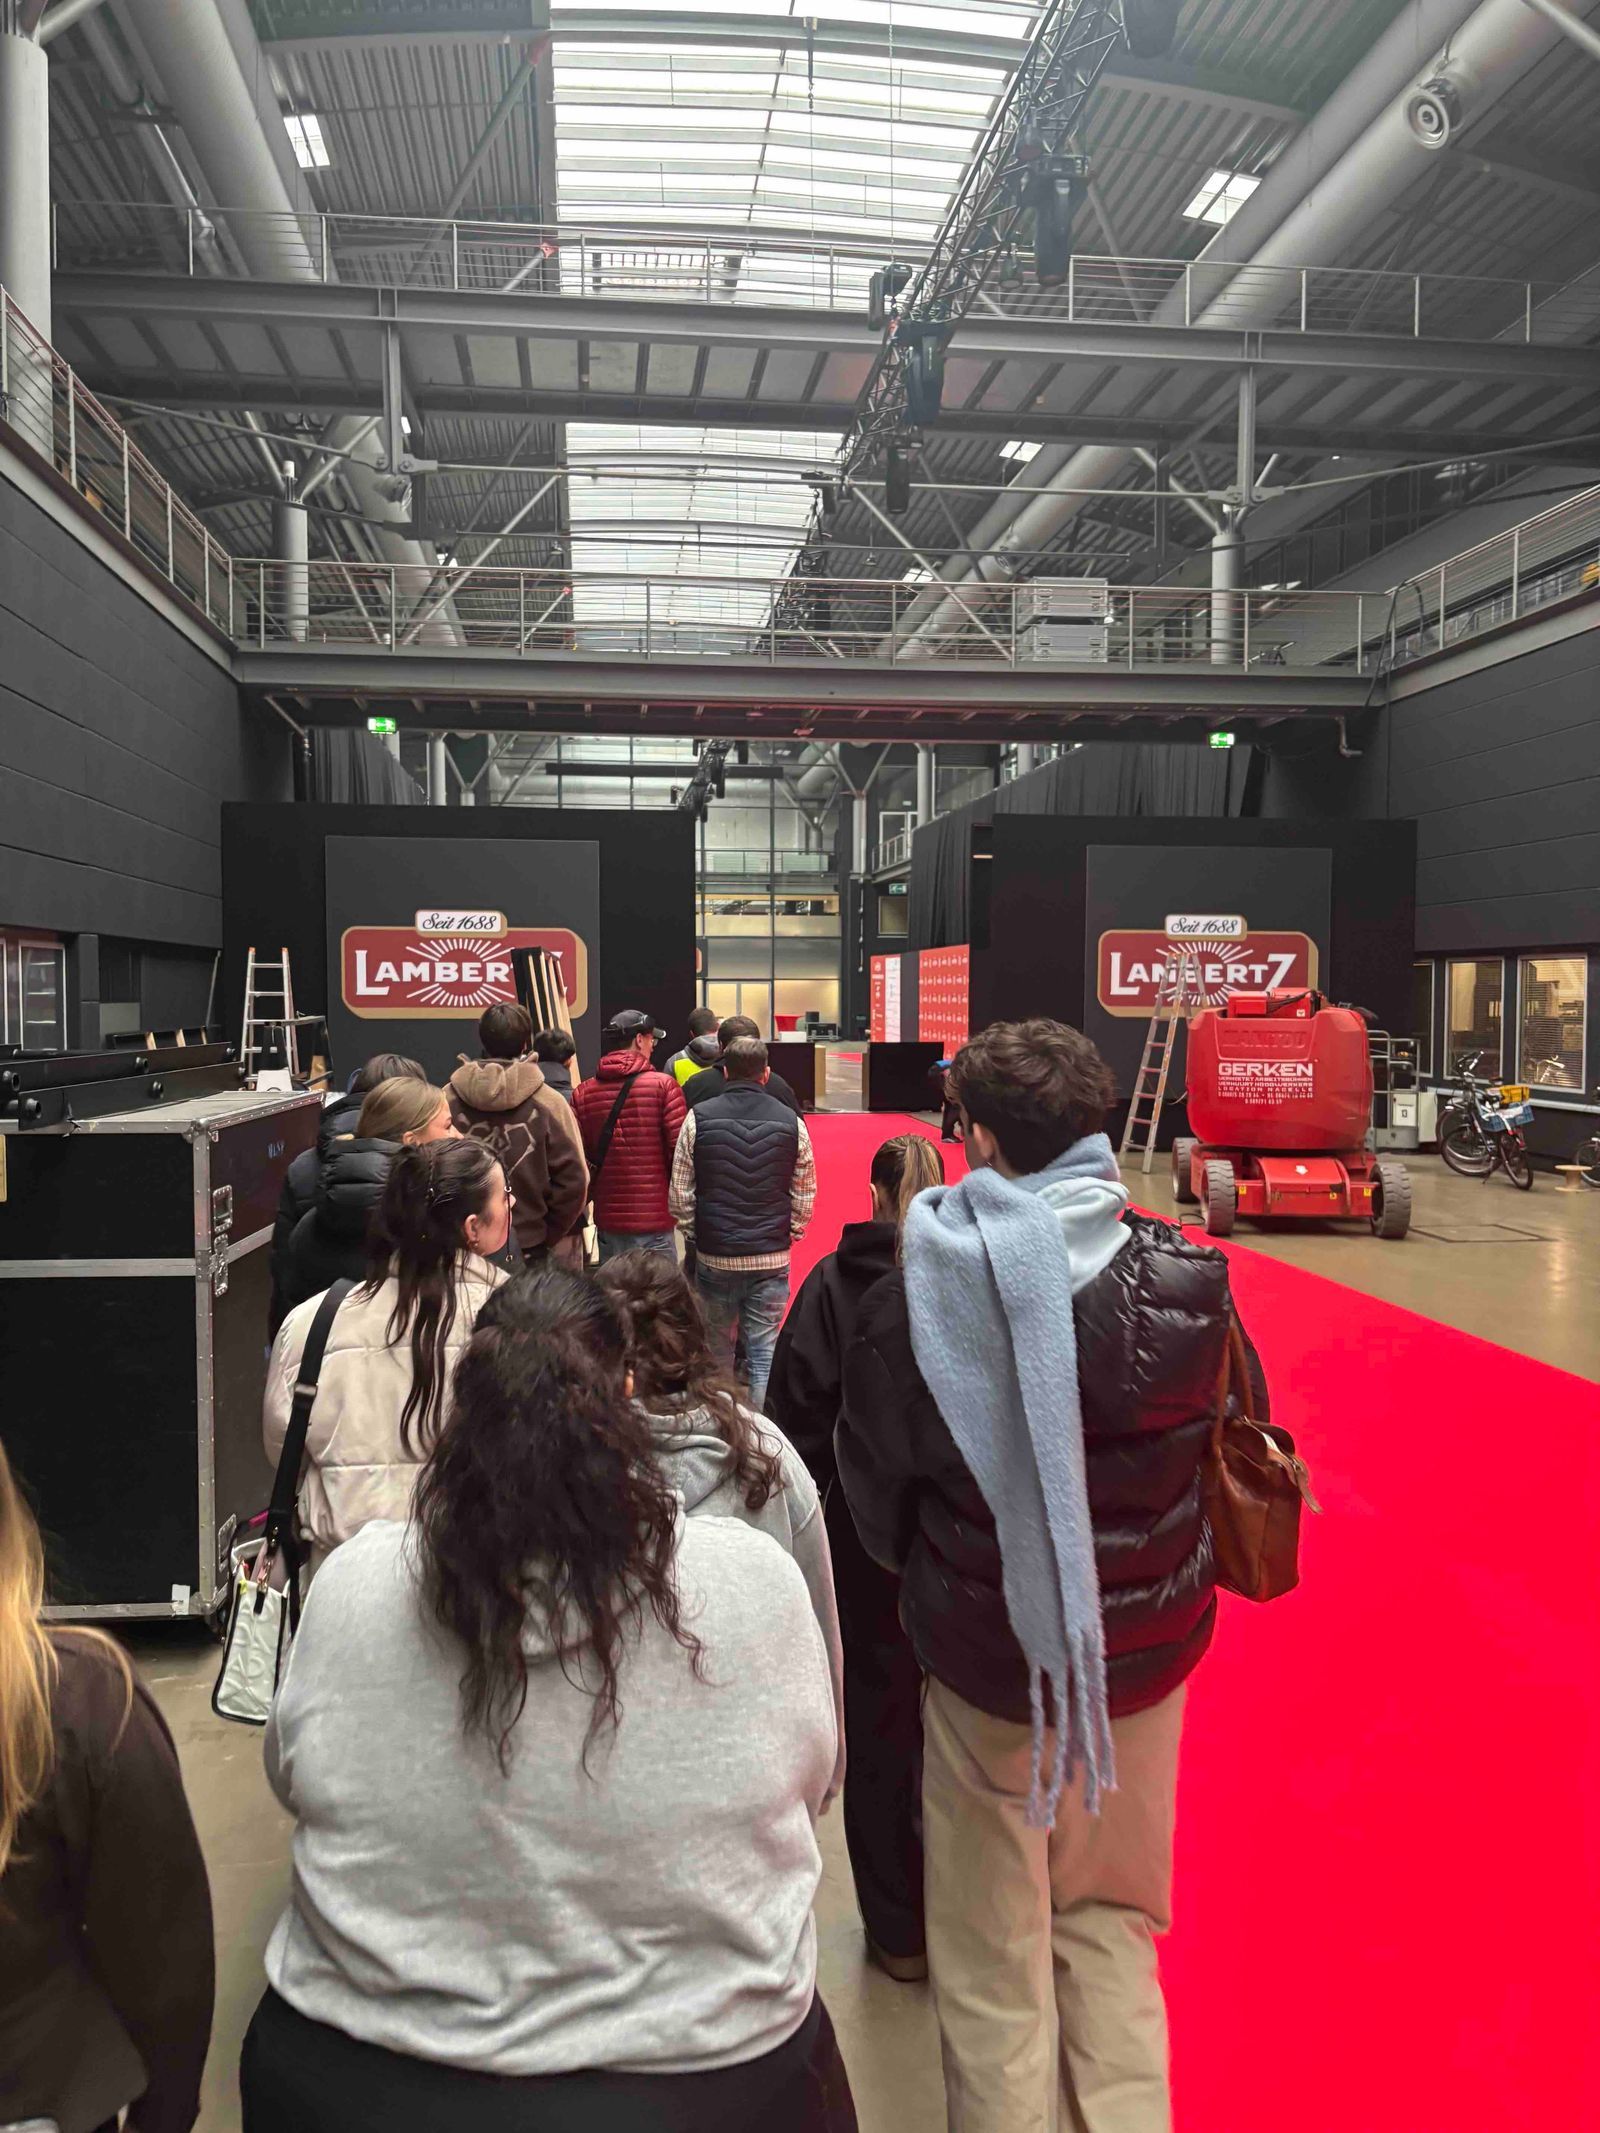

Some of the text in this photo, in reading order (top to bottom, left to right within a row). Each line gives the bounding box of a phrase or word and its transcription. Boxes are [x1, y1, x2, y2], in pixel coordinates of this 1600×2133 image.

[422, 912, 497, 930] Seit 1688
[1171, 917, 1238, 934] Seit 1688
[355, 950, 567, 996] LAMBER
[1218, 1062, 1313, 1077] GERKEN
